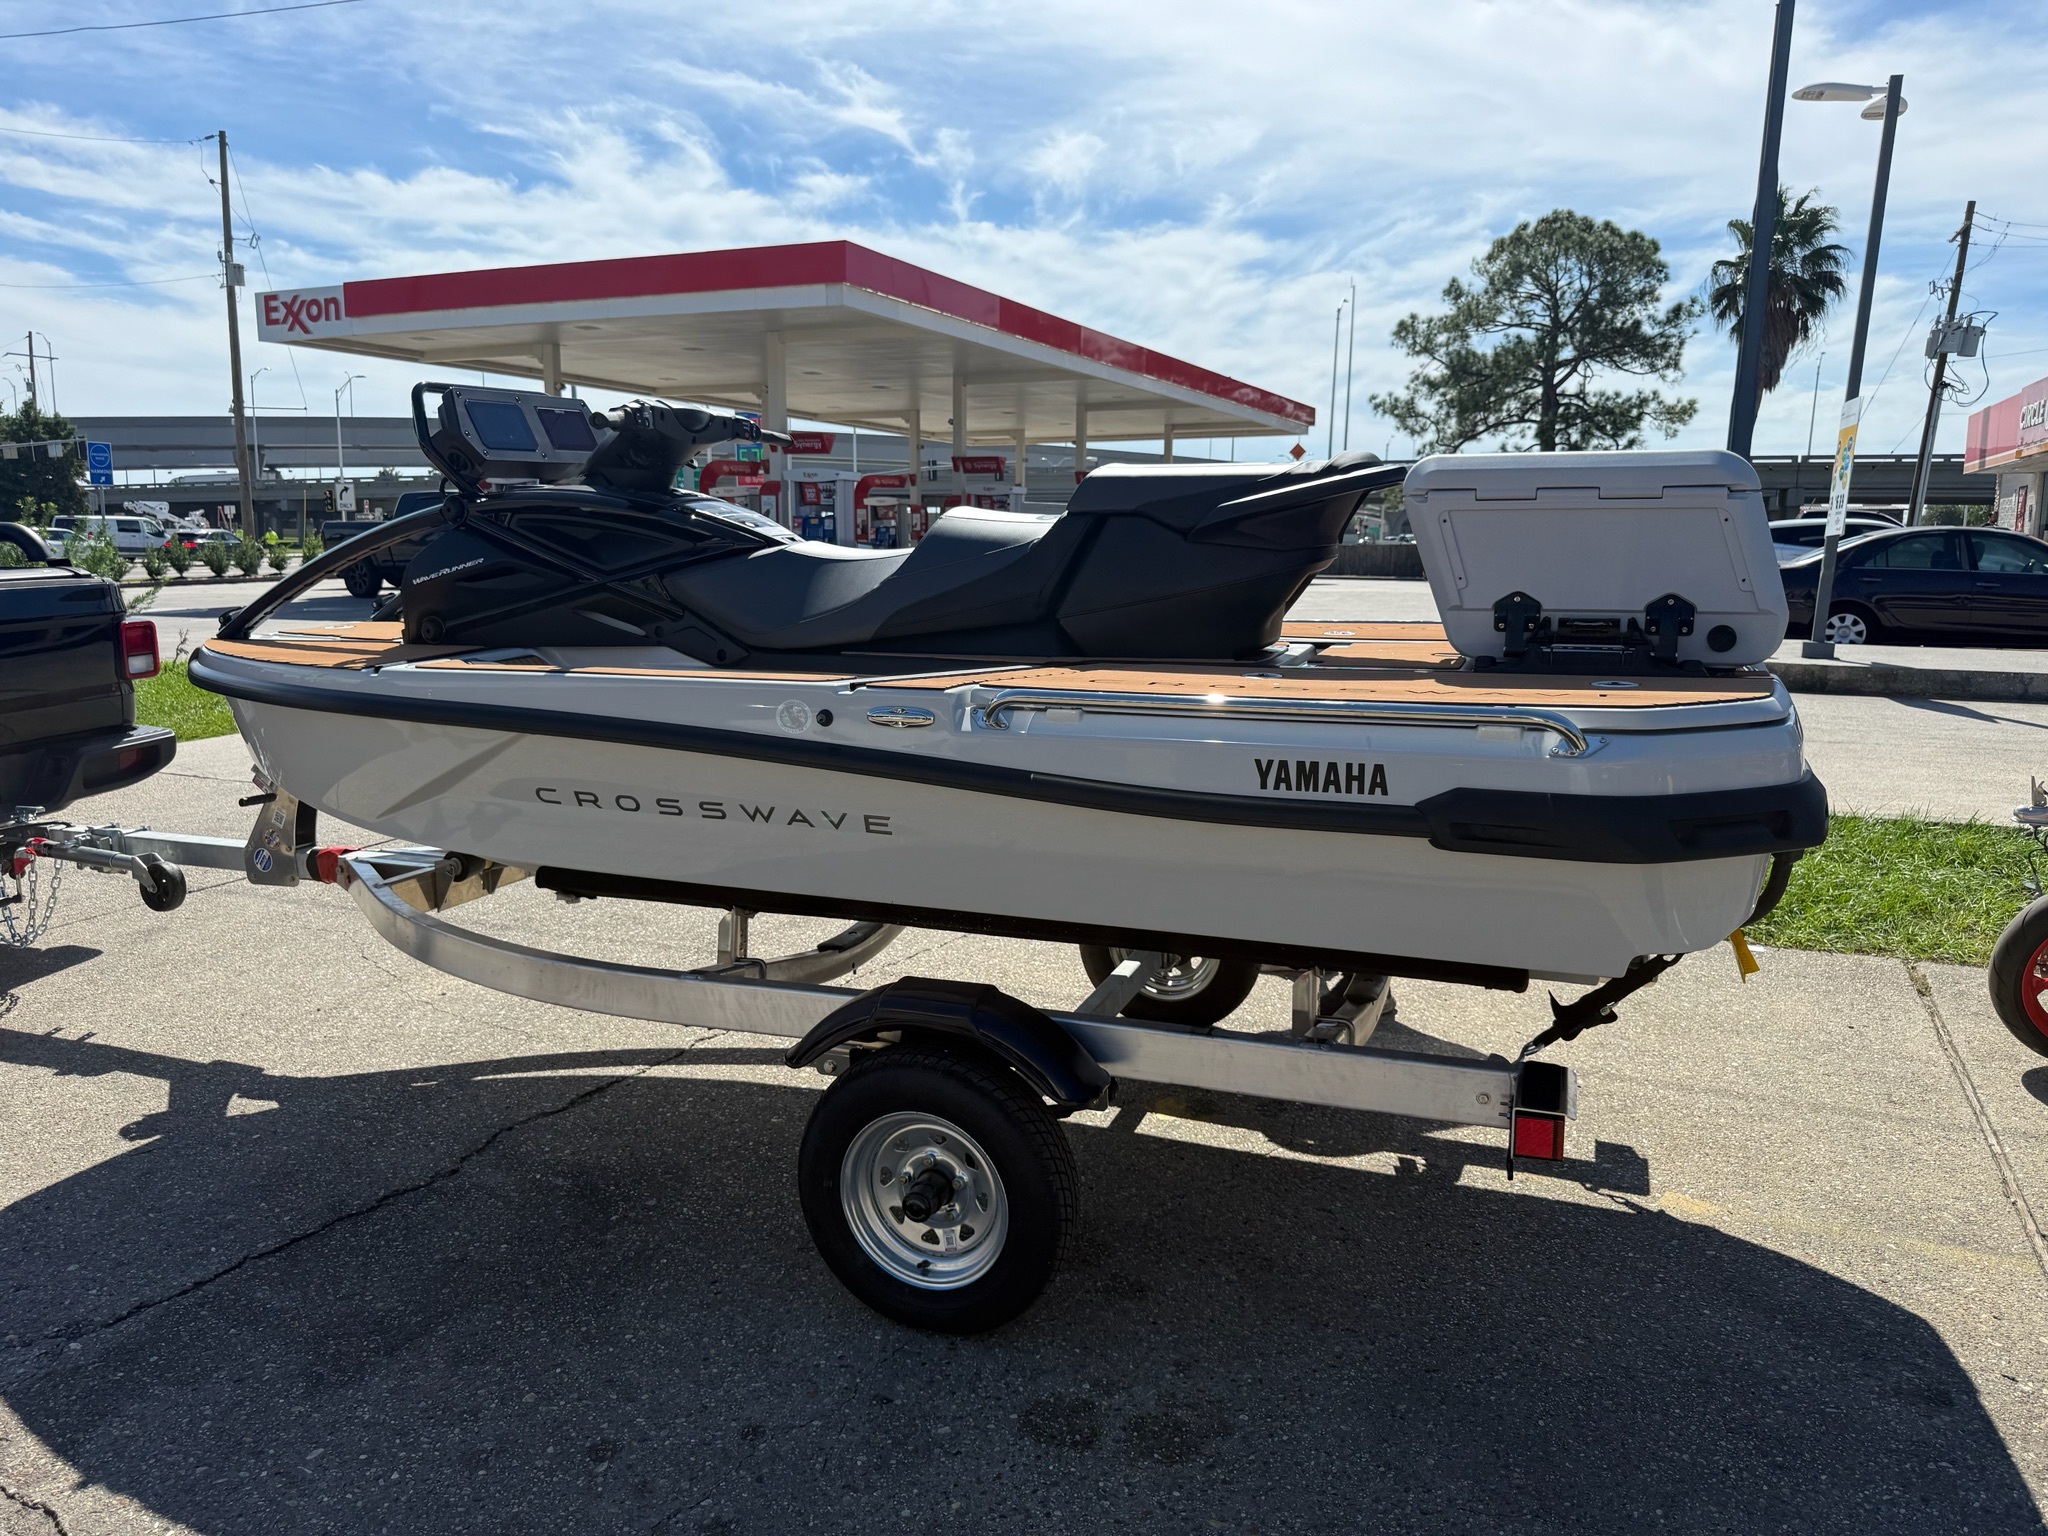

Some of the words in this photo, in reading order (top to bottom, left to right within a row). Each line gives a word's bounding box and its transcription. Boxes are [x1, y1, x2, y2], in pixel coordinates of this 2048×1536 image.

[263, 294, 341, 335] Exxon
[1254, 758, 1389, 797] YAMAHA
[534, 787, 893, 836] CROSSWAVE
